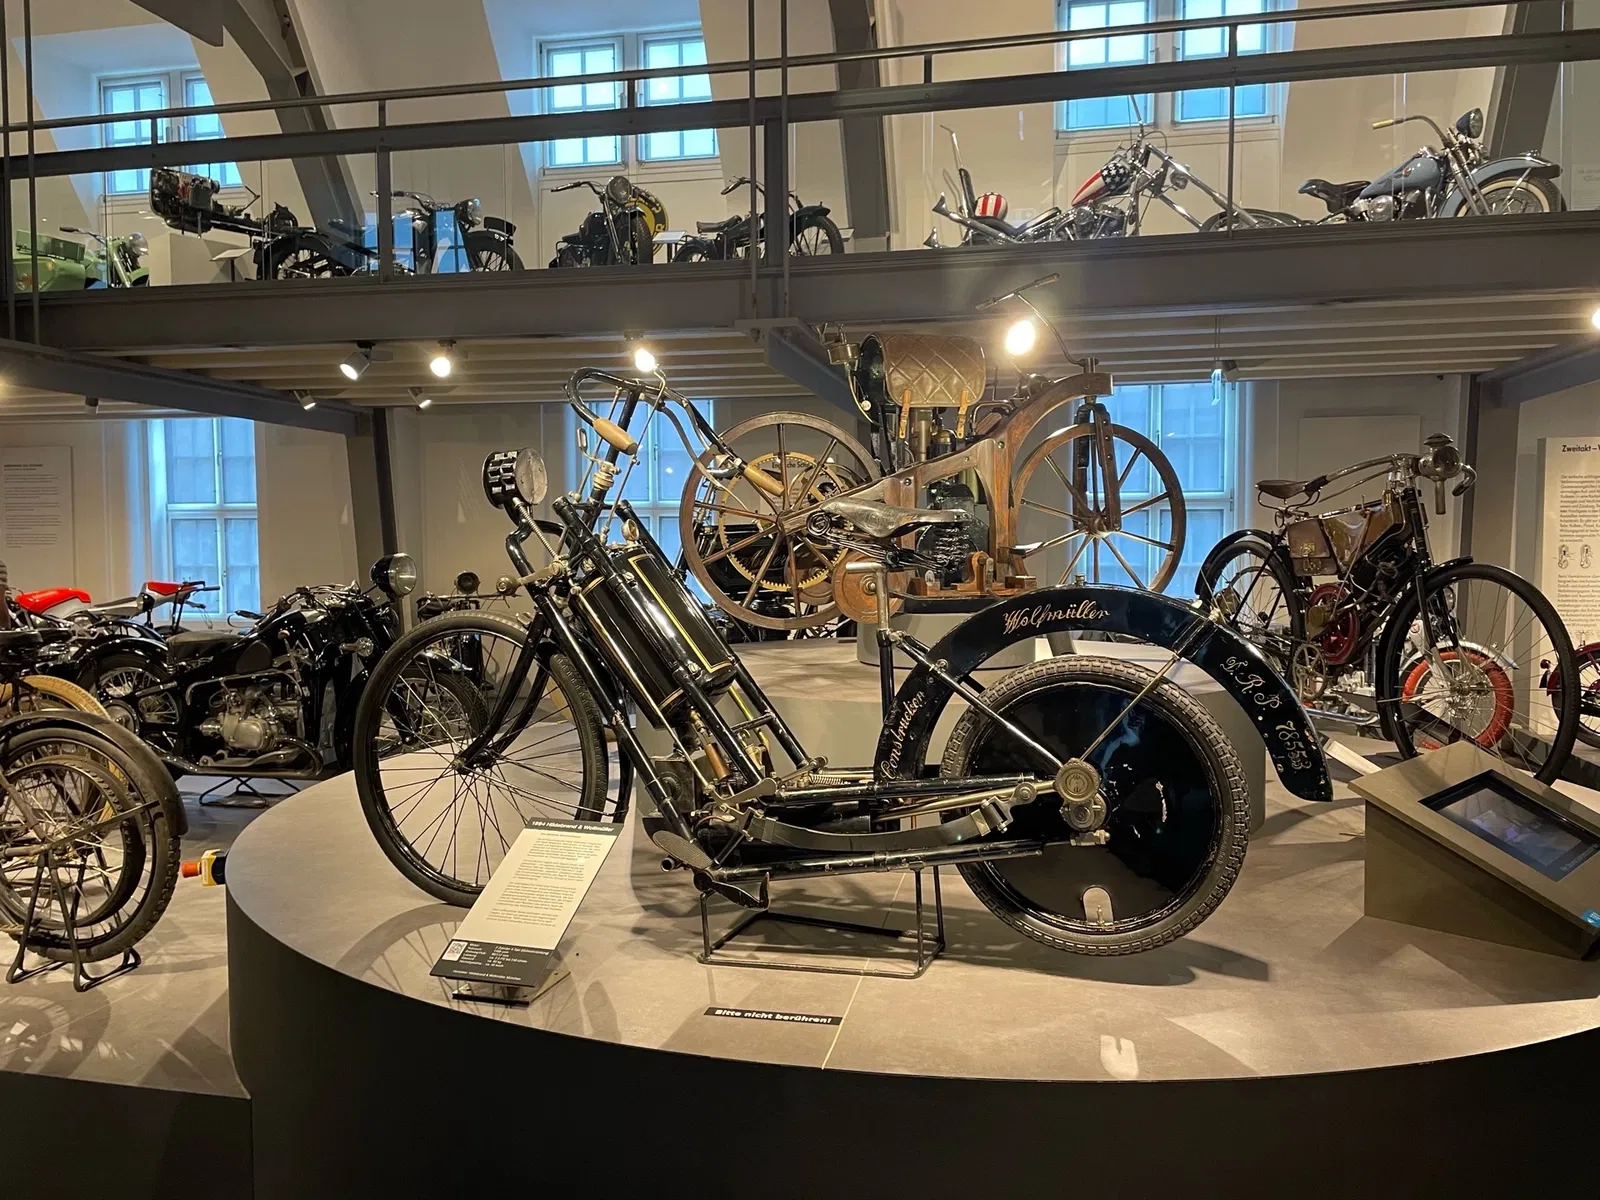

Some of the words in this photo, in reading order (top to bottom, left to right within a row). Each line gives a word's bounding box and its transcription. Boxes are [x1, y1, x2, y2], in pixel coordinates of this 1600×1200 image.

[1562, 444, 1591, 452] Zweitakt
[1002, 599, 1111, 635] Wolfmüller
[880, 690, 925, 779] Construction
[1275, 720, 1312, 770] 78553
[774, 1013, 832, 1024] berühren!
